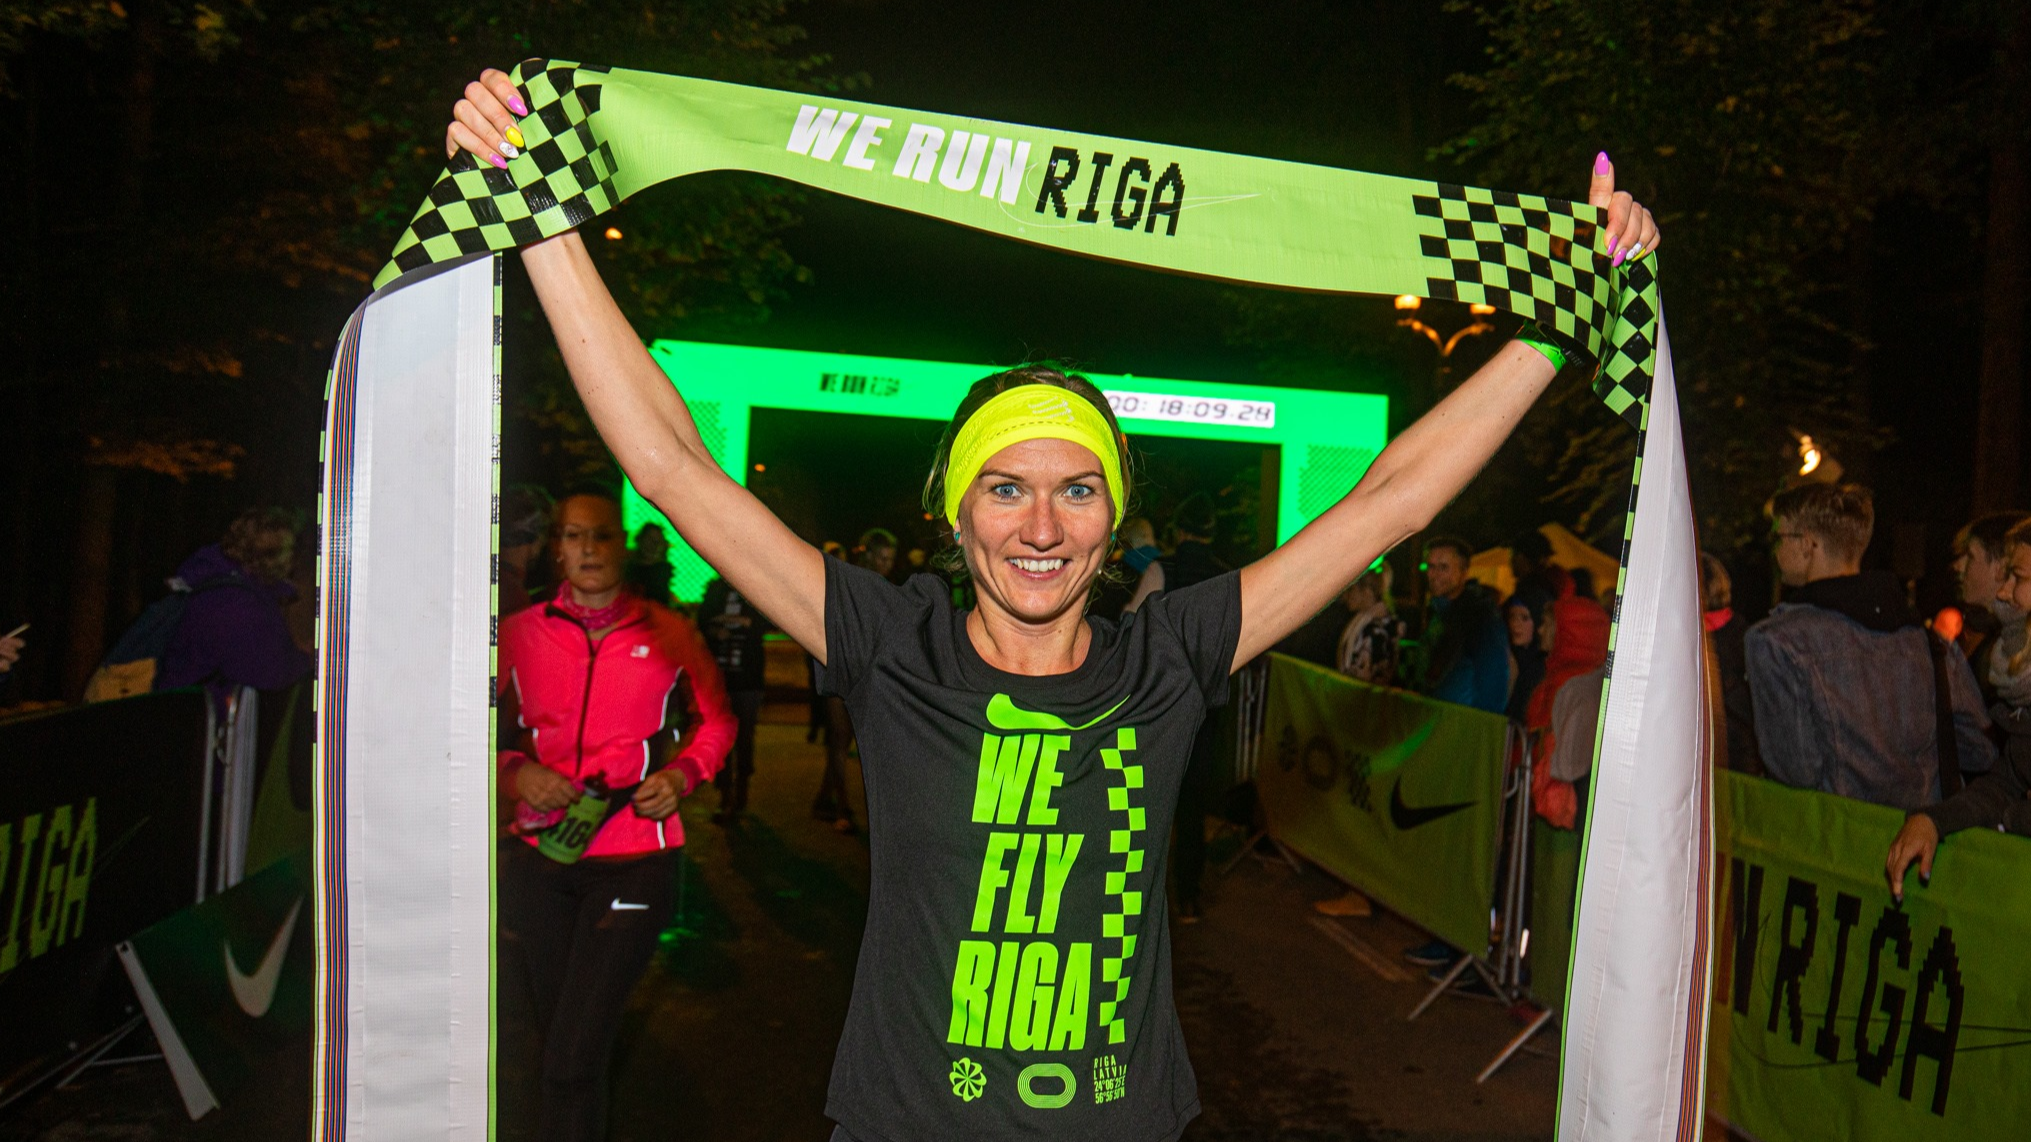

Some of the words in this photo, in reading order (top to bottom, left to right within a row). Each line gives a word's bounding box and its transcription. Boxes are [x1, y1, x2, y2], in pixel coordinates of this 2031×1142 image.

[786, 104, 892, 172] WE
[892, 123, 1031, 206] RUN
[1035, 145, 1186, 237] RIGA
[971, 732, 1072, 826] WE
[0, 797, 97, 973] IGA
[970, 832, 1085, 934] FLY
[946, 940, 1093, 1052] RIGA
[1767, 875, 1965, 1118] RIGA
[1093, 1054, 1117, 1069] RIGA
